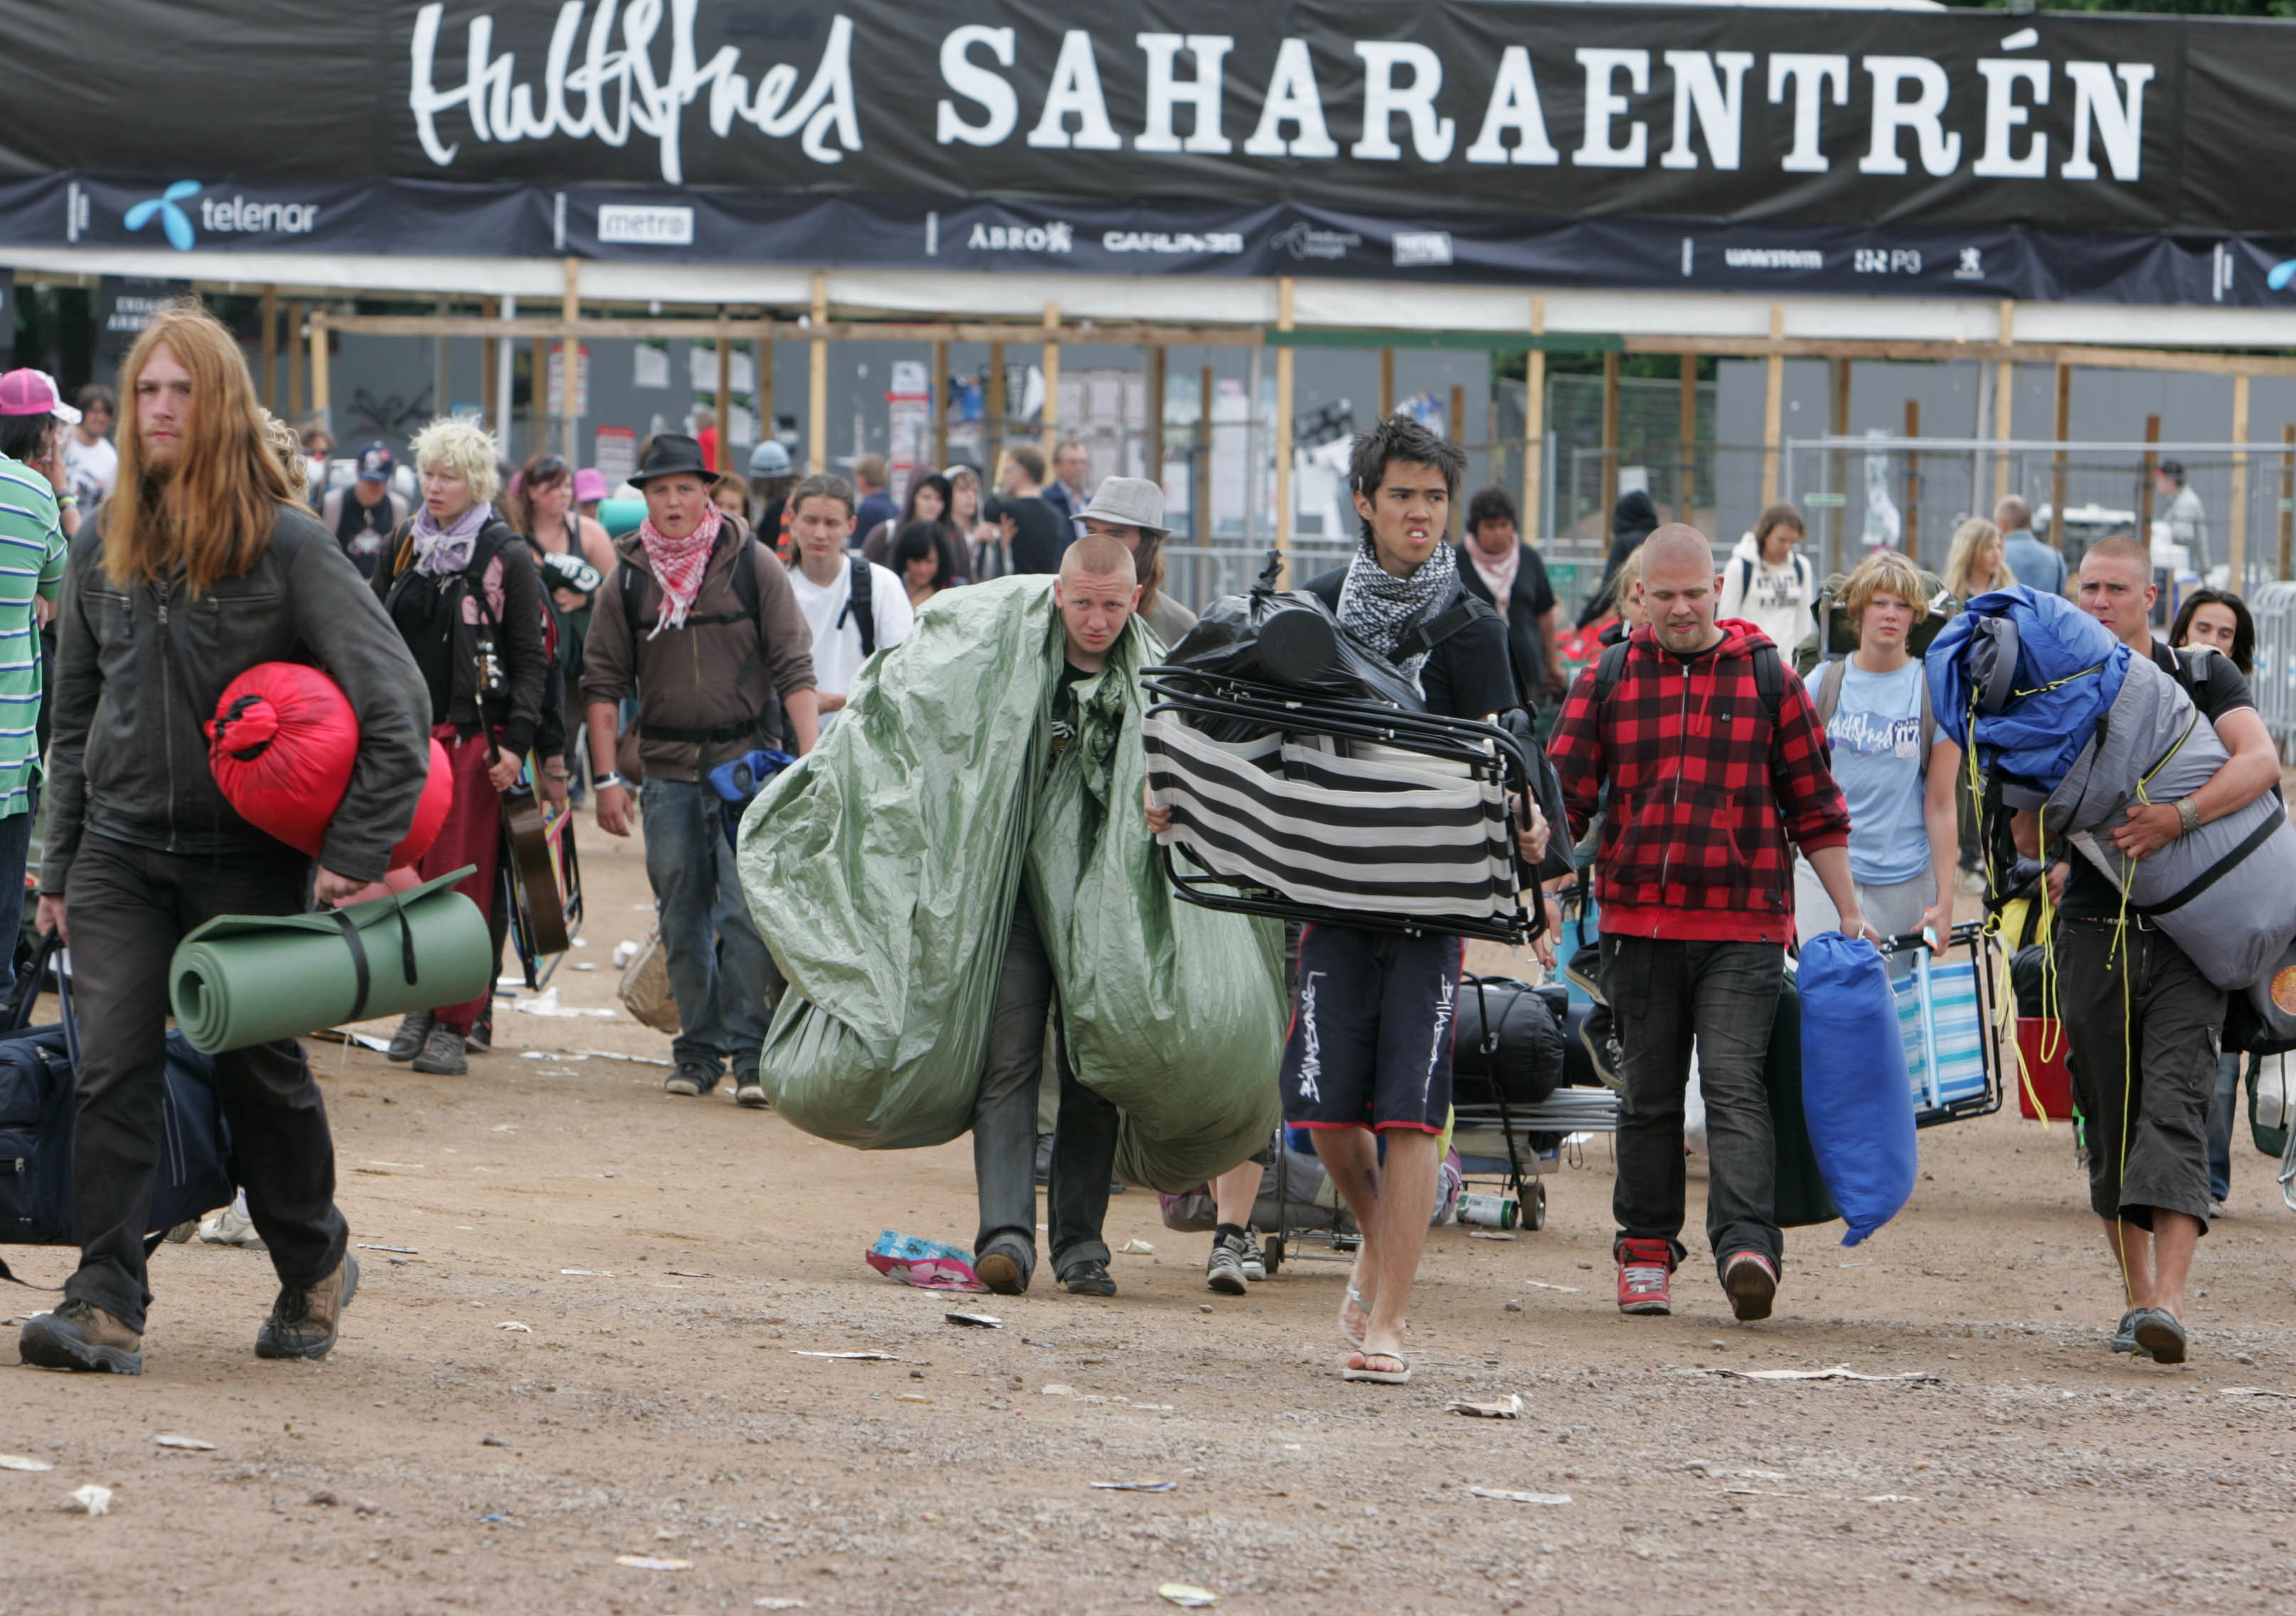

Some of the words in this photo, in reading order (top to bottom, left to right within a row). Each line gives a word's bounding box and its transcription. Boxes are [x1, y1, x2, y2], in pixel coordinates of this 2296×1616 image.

[410, 0, 861, 183] Hultsfred
[937, 25, 2155, 181] SAHARAENTRÉN
[201, 195, 319, 233] telenor
[605, 211, 686, 235] metro
[1891, 249, 1922, 274] P3
